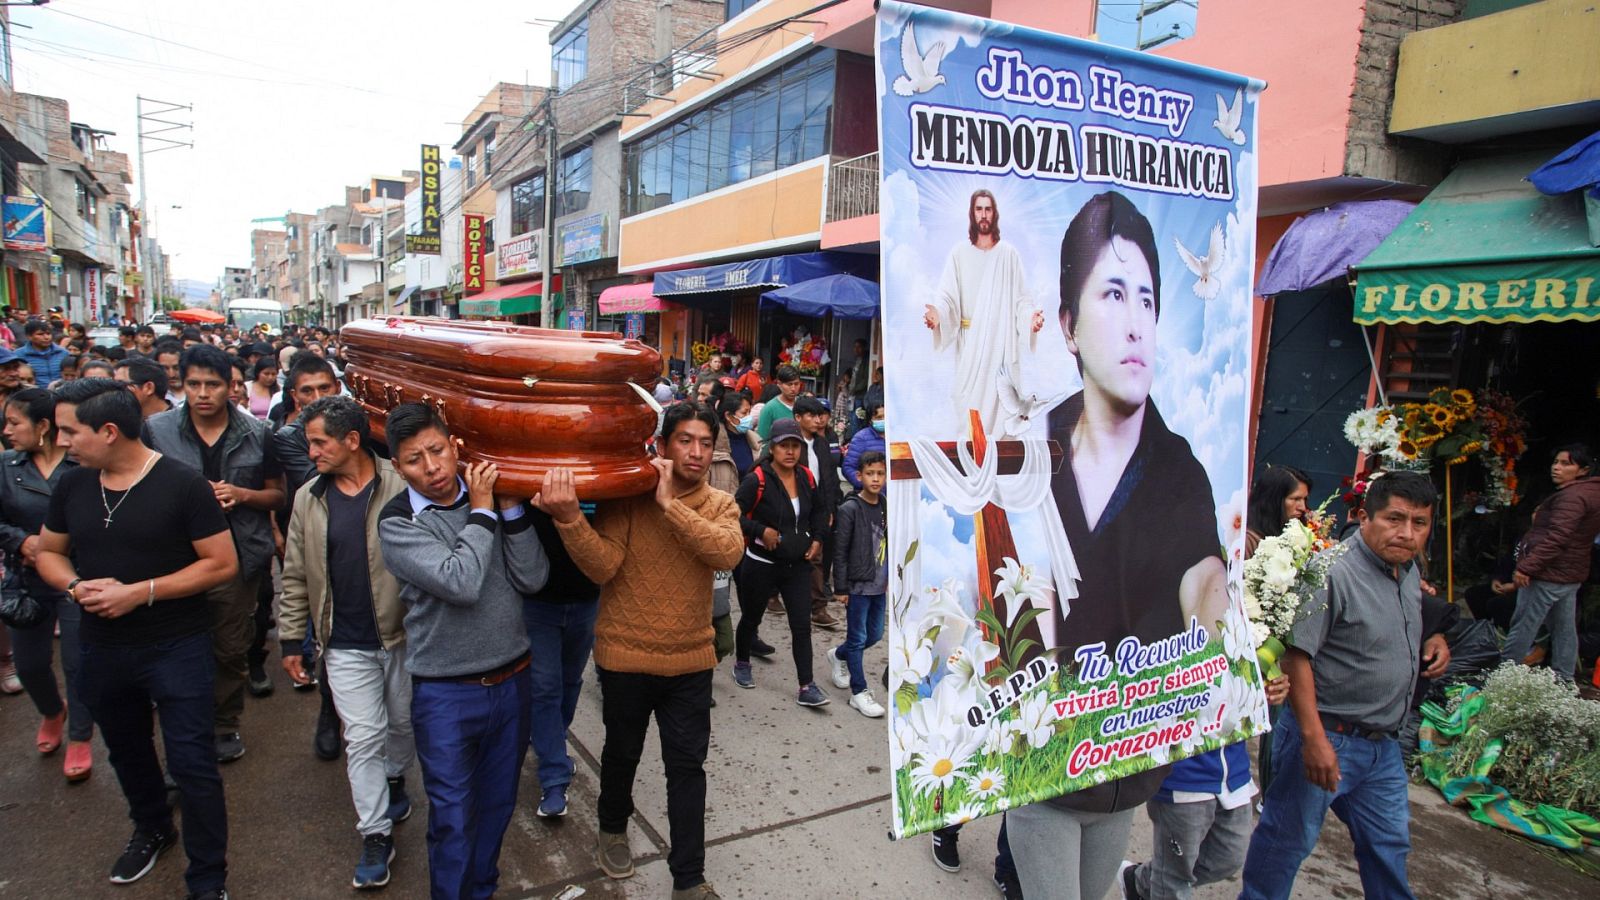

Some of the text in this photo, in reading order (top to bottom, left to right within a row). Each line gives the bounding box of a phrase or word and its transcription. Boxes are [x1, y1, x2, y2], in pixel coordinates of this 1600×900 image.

[980, 53, 1191, 133] Jhon Henry
[915, 110, 1231, 195] MENDOZA HUARANCCA
[423, 146, 438, 232] HOSTAL
[467, 218, 482, 288] BOTICA
[1076, 617, 1207, 682] Tu Recuerdo
[967, 659, 1056, 728] Q.E.P.D.
[1054, 656, 1228, 718] vivirá por siempre
[1102, 691, 1210, 734] en nuestros
[1068, 718, 1194, 776] Corazones
